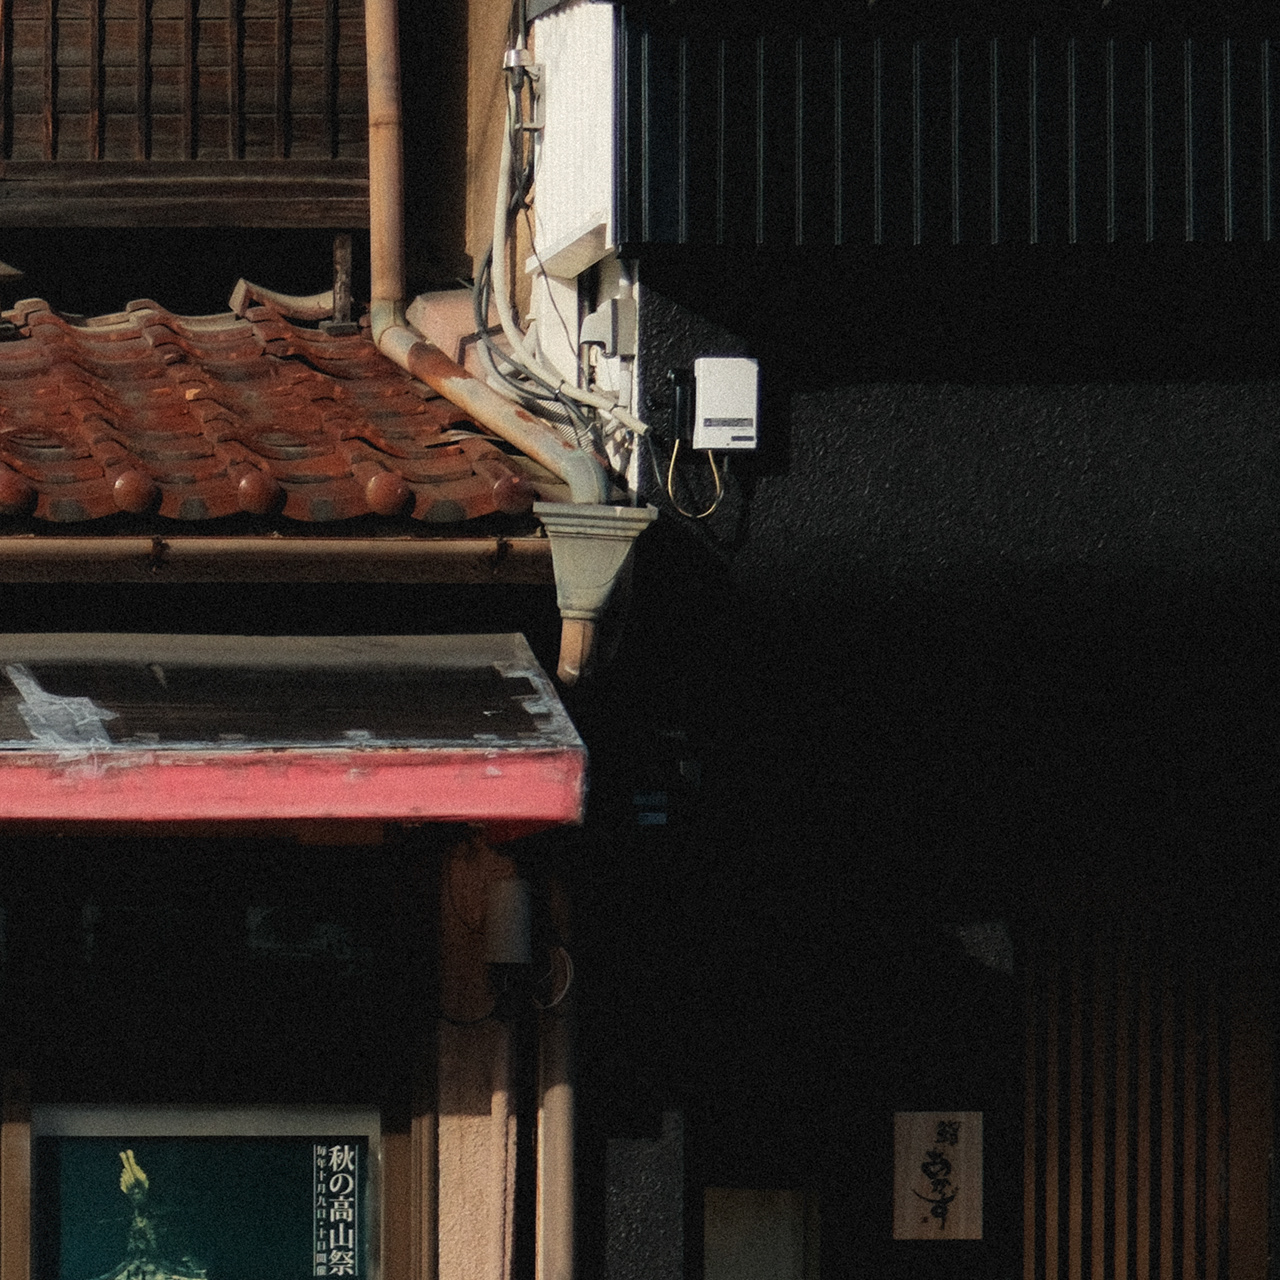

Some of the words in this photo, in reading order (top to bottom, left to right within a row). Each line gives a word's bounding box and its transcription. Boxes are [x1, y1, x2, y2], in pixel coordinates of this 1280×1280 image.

[328, 1144, 354, 1276] 秋の高山祭
